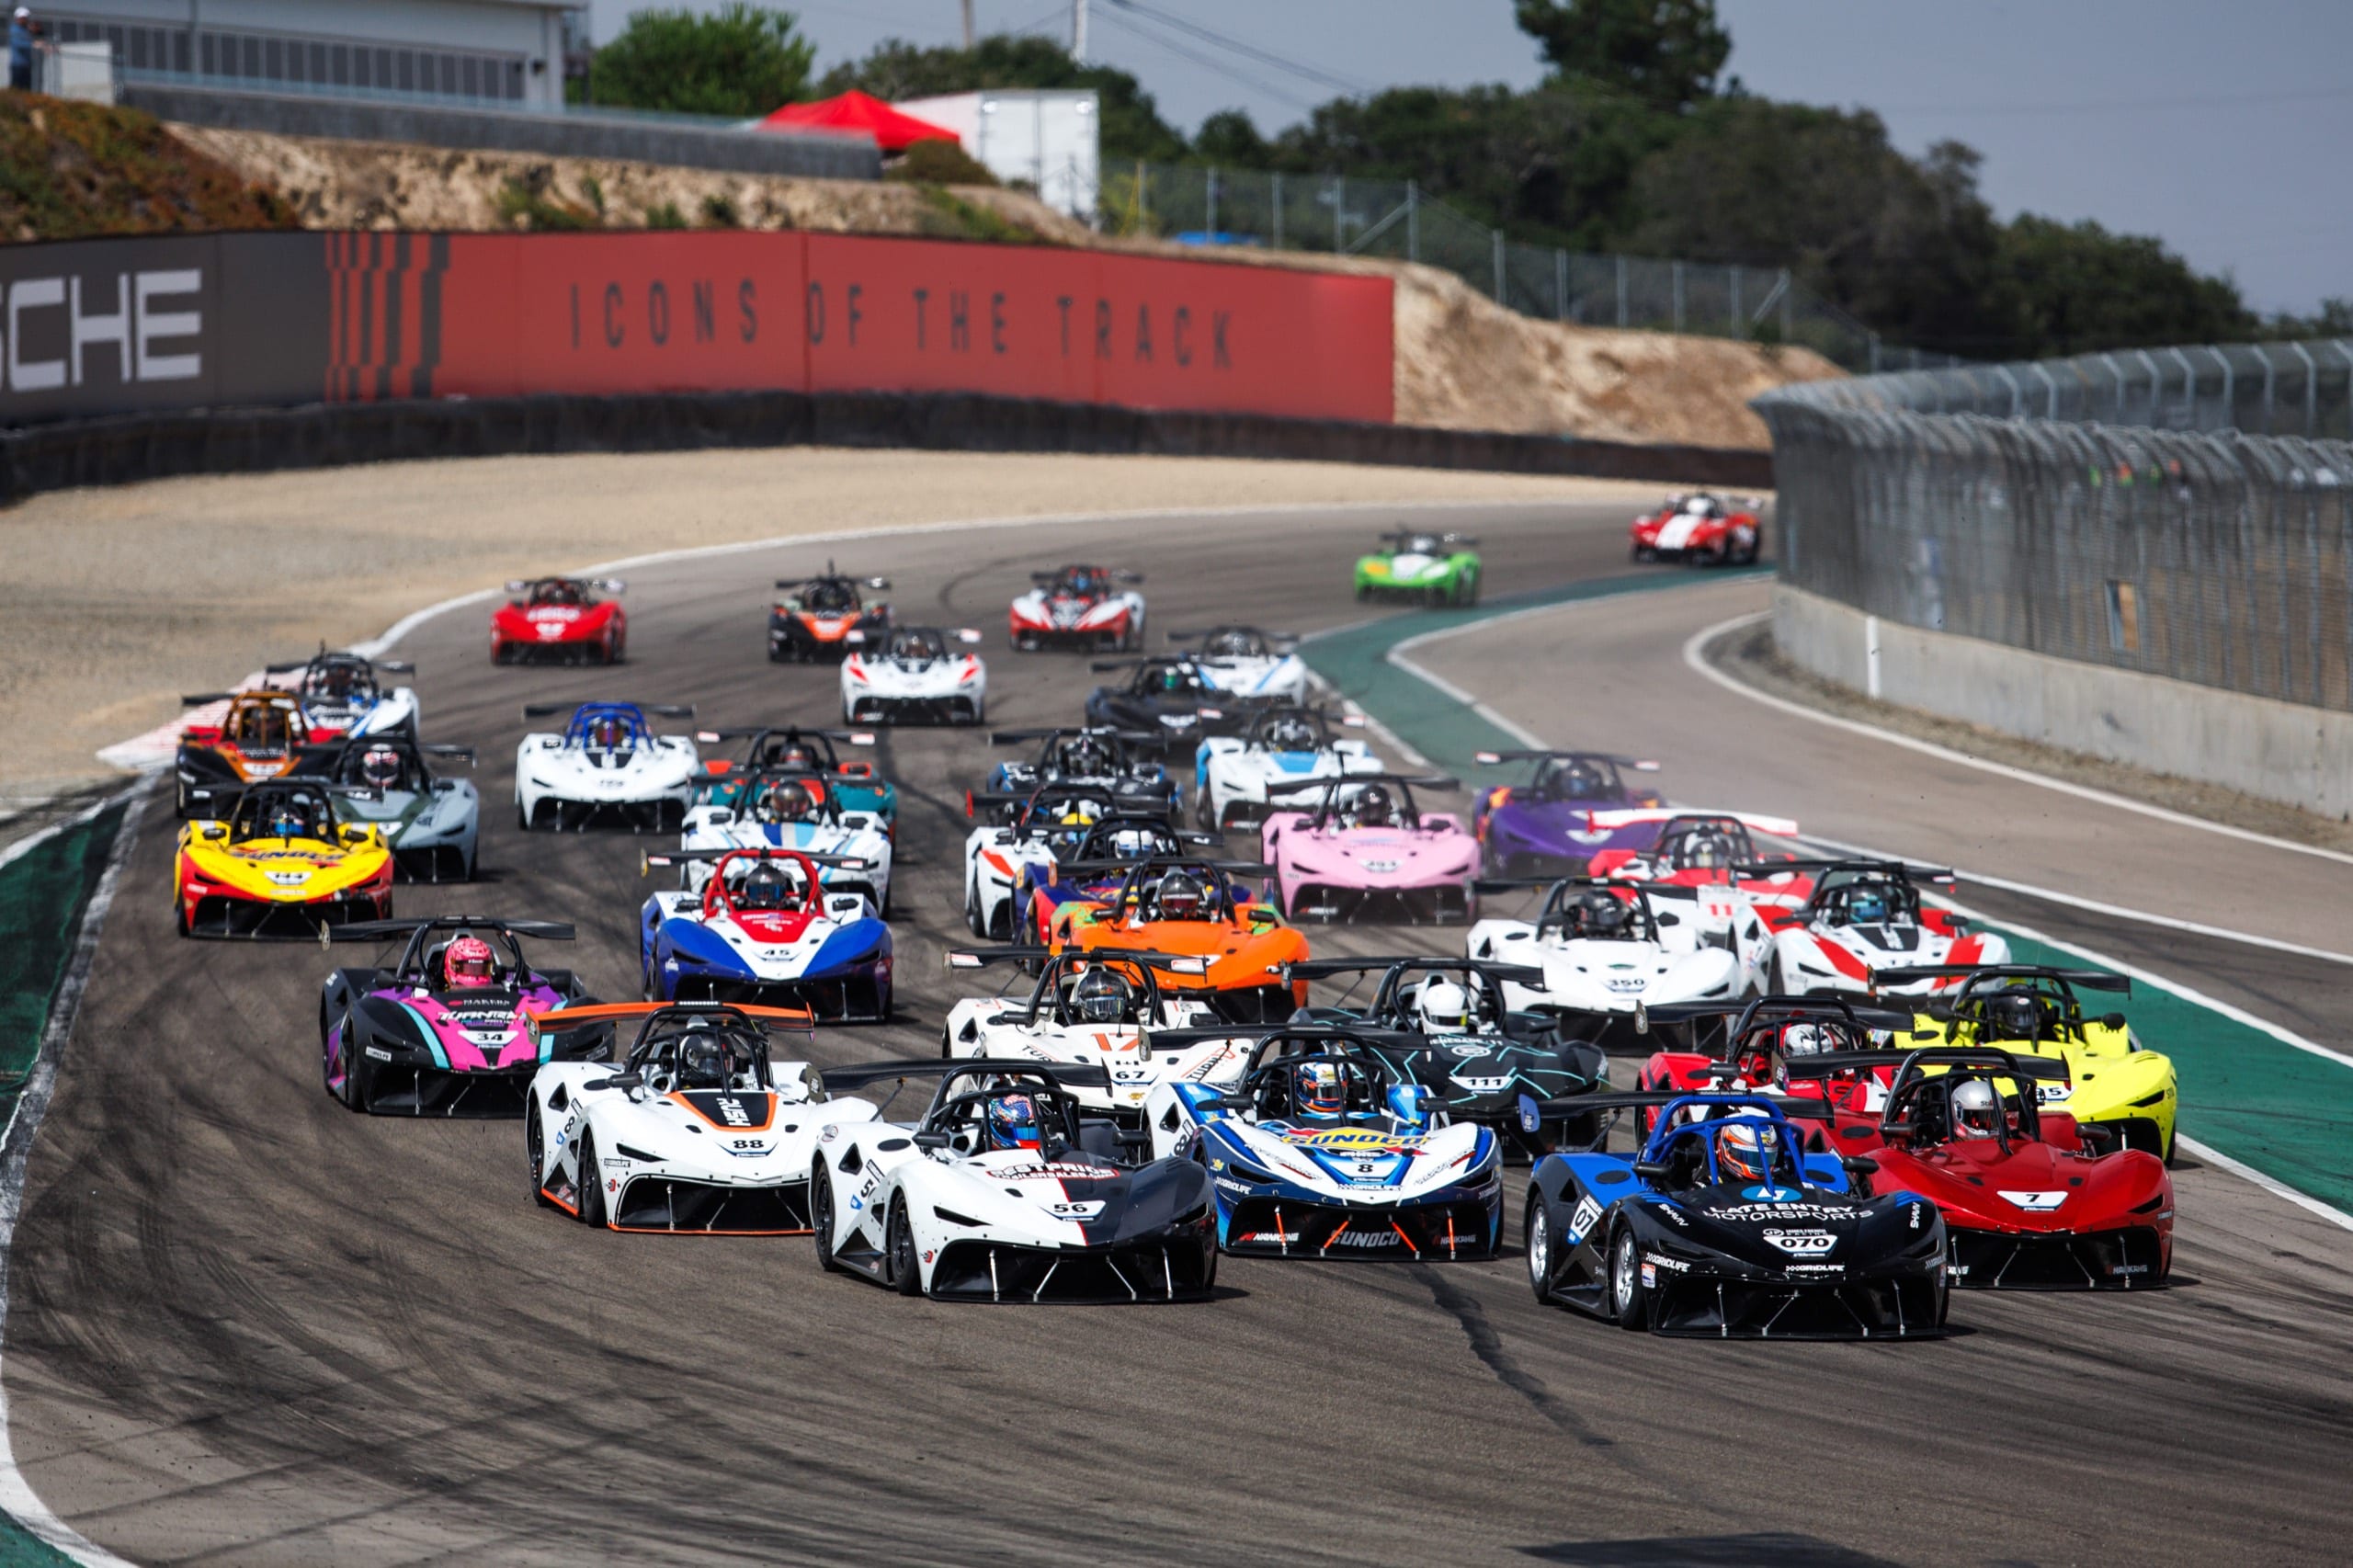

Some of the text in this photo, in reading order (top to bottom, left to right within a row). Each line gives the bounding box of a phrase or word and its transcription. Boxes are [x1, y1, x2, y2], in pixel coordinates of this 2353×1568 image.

[568, 281, 1233, 369] ICONS OF THE TRACK
[0, 269, 201, 392] CHE
[1608, 978, 1645, 986] 350
[477, 1033, 503, 1041] 34
[1090, 1032, 1140, 1051] 17
[1021, 1044, 1055, 1062] TUR
[1115, 1071, 1146, 1079] 67
[733, 1140, 765, 1149] 88
[1283, 1134, 1427, 1145] SUNOCO
[1358, 1164, 1374, 1173] 8
[2025, 1193, 2040, 1203] 7
[1053, 1203, 1088, 1212] 56
[1710, 1202, 1853, 1214] LATE ENTRY
[1702, 1209, 1875, 1222] MOTORSPORTS
[1330, 1229, 1401, 1247] SUNOCO
[1779, 1238, 1830, 1247] 070
